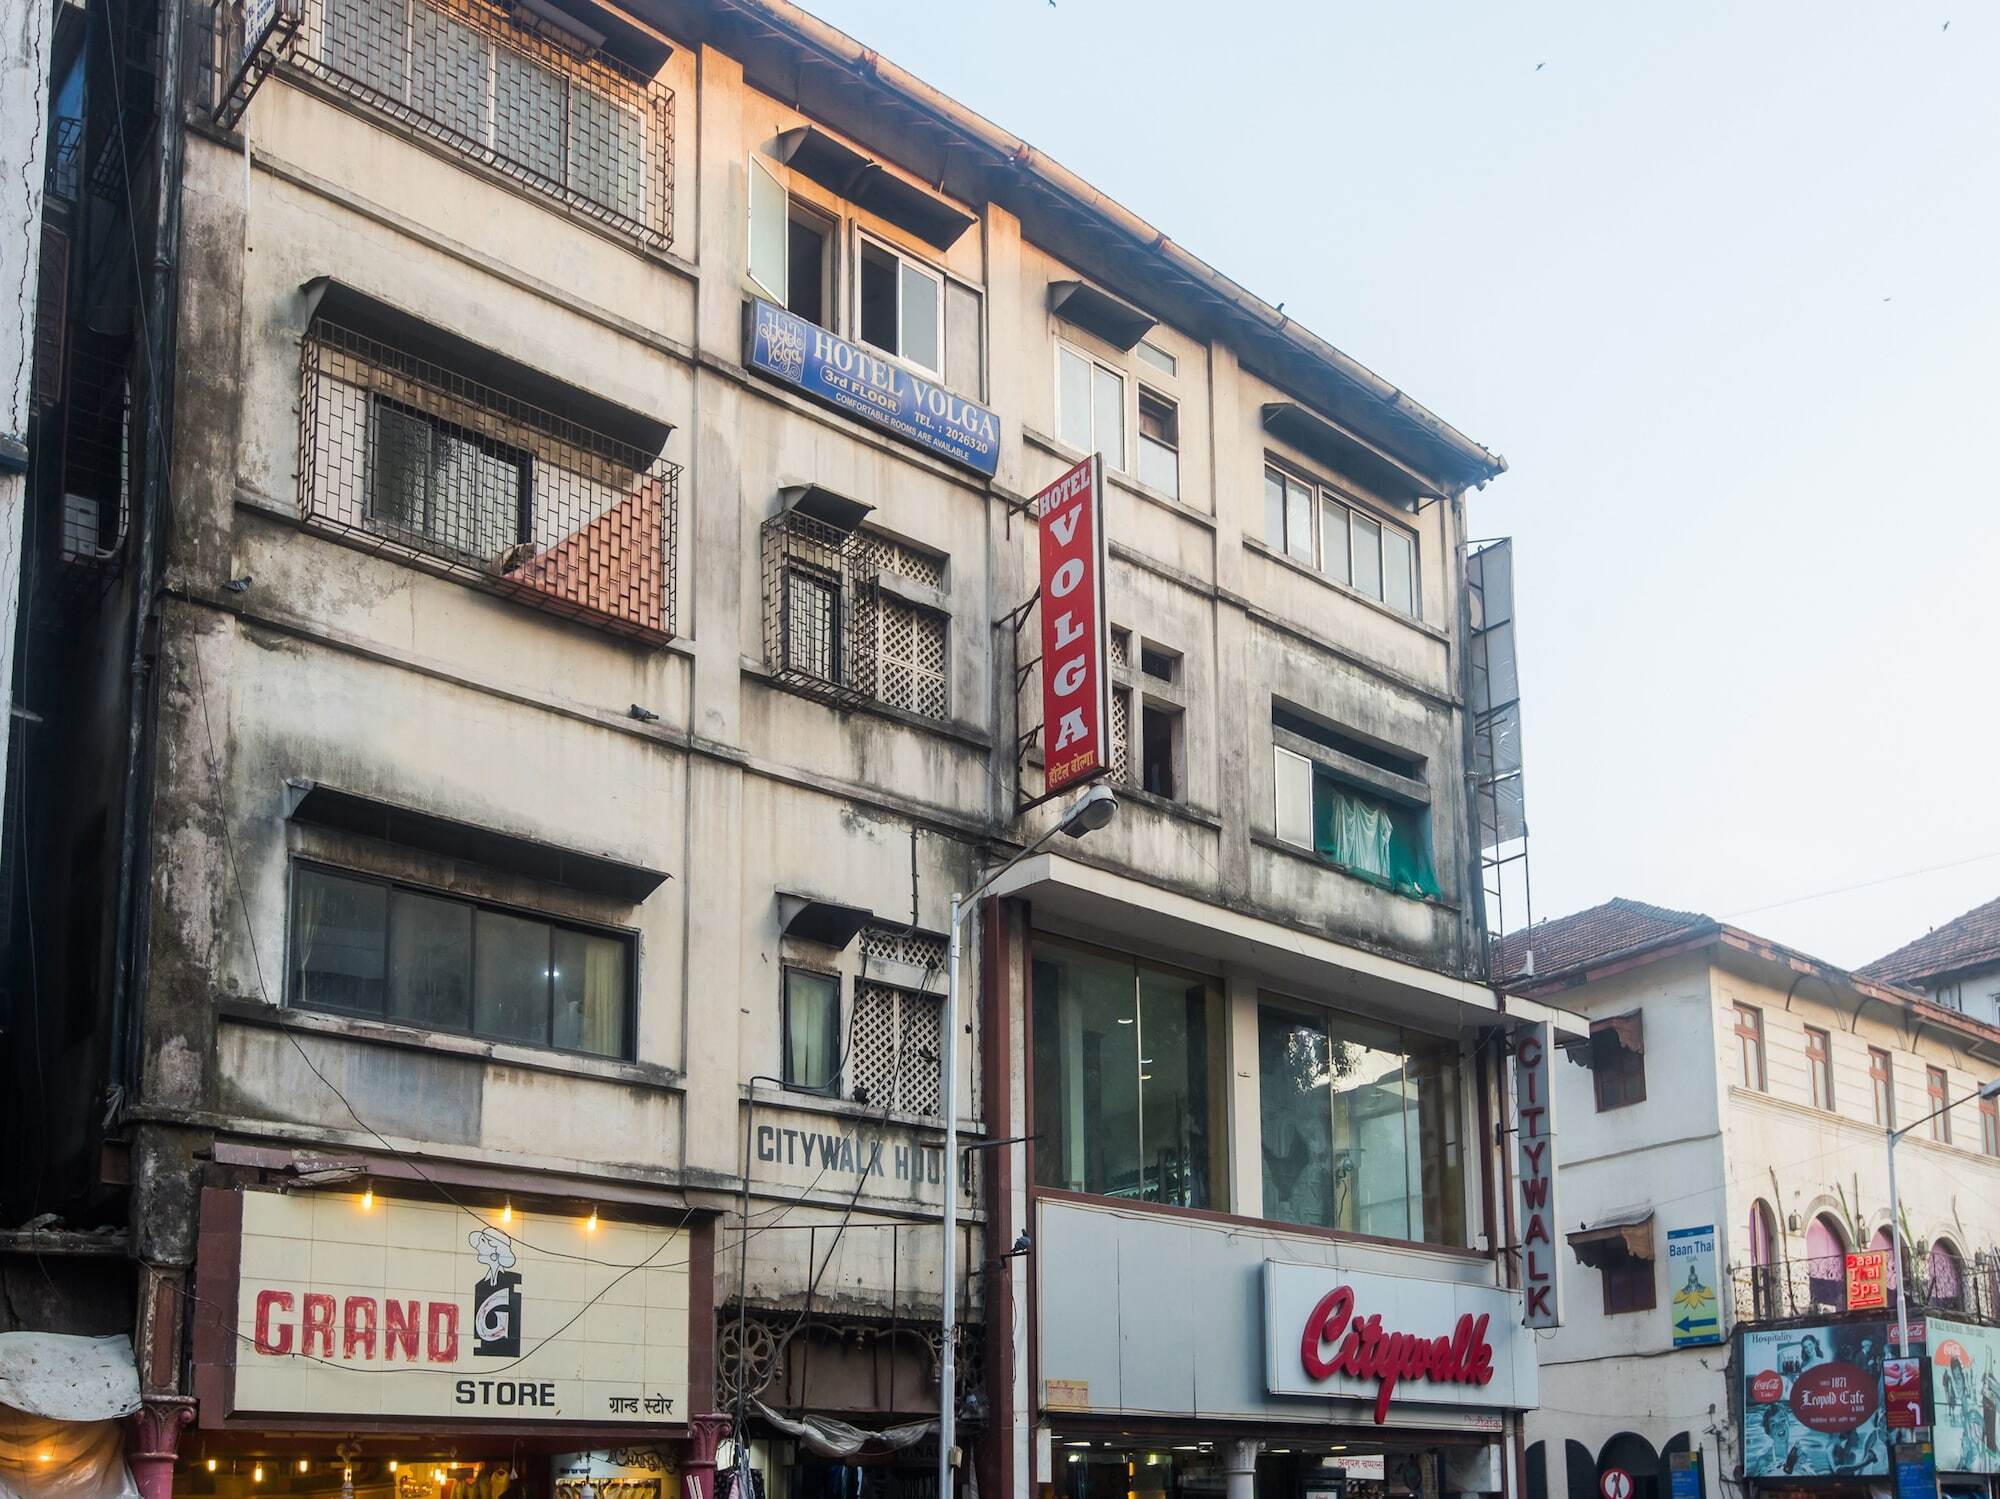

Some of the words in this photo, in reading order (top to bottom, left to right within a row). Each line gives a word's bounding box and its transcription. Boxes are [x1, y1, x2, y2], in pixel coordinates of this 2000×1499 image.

[814, 331, 904, 397] HOTEL
[910, 378, 996, 442] VOLGA
[825, 369, 848, 389] 3rd
[851, 381, 897, 413] FLOOR
[835, 392, 890, 424] COMFORTABLE
[889, 418, 917, 436] ROOMS
[917, 430, 932, 444] ARE
[932, 438, 970, 460] AVAILABLE
[914, 411, 935, 430] TEL.
[946, 426, 988, 454] 2026320
[1039, 466, 1090, 519] HOTEL
[1050, 502, 1089, 752] VOLGA
[757, 1125, 885, 1177] CITYWALK
[895, 1145, 970, 1188] HOUE
[1518, 1036, 1551, 1317] CITYWALK
[1669, 1244, 1693, 1257] Baan
[1848, 1265, 1880, 1281] Tai
[1850, 1281, 1880, 1299] Spa
[254, 1289, 459, 1363] GRAND
[1752, 1331, 1793, 1345] Hospitality
[1301, 1284, 1494, 1425] Citywalk
[455, 1380, 556, 1407] STORE
[644, 1392, 675, 1415] स्टोर
[1801, 1390, 1837, 1408] Leopold
[1840, 1390, 1864, 1405] Cafe
[1831, 1377, 1847, 1388] 1871
